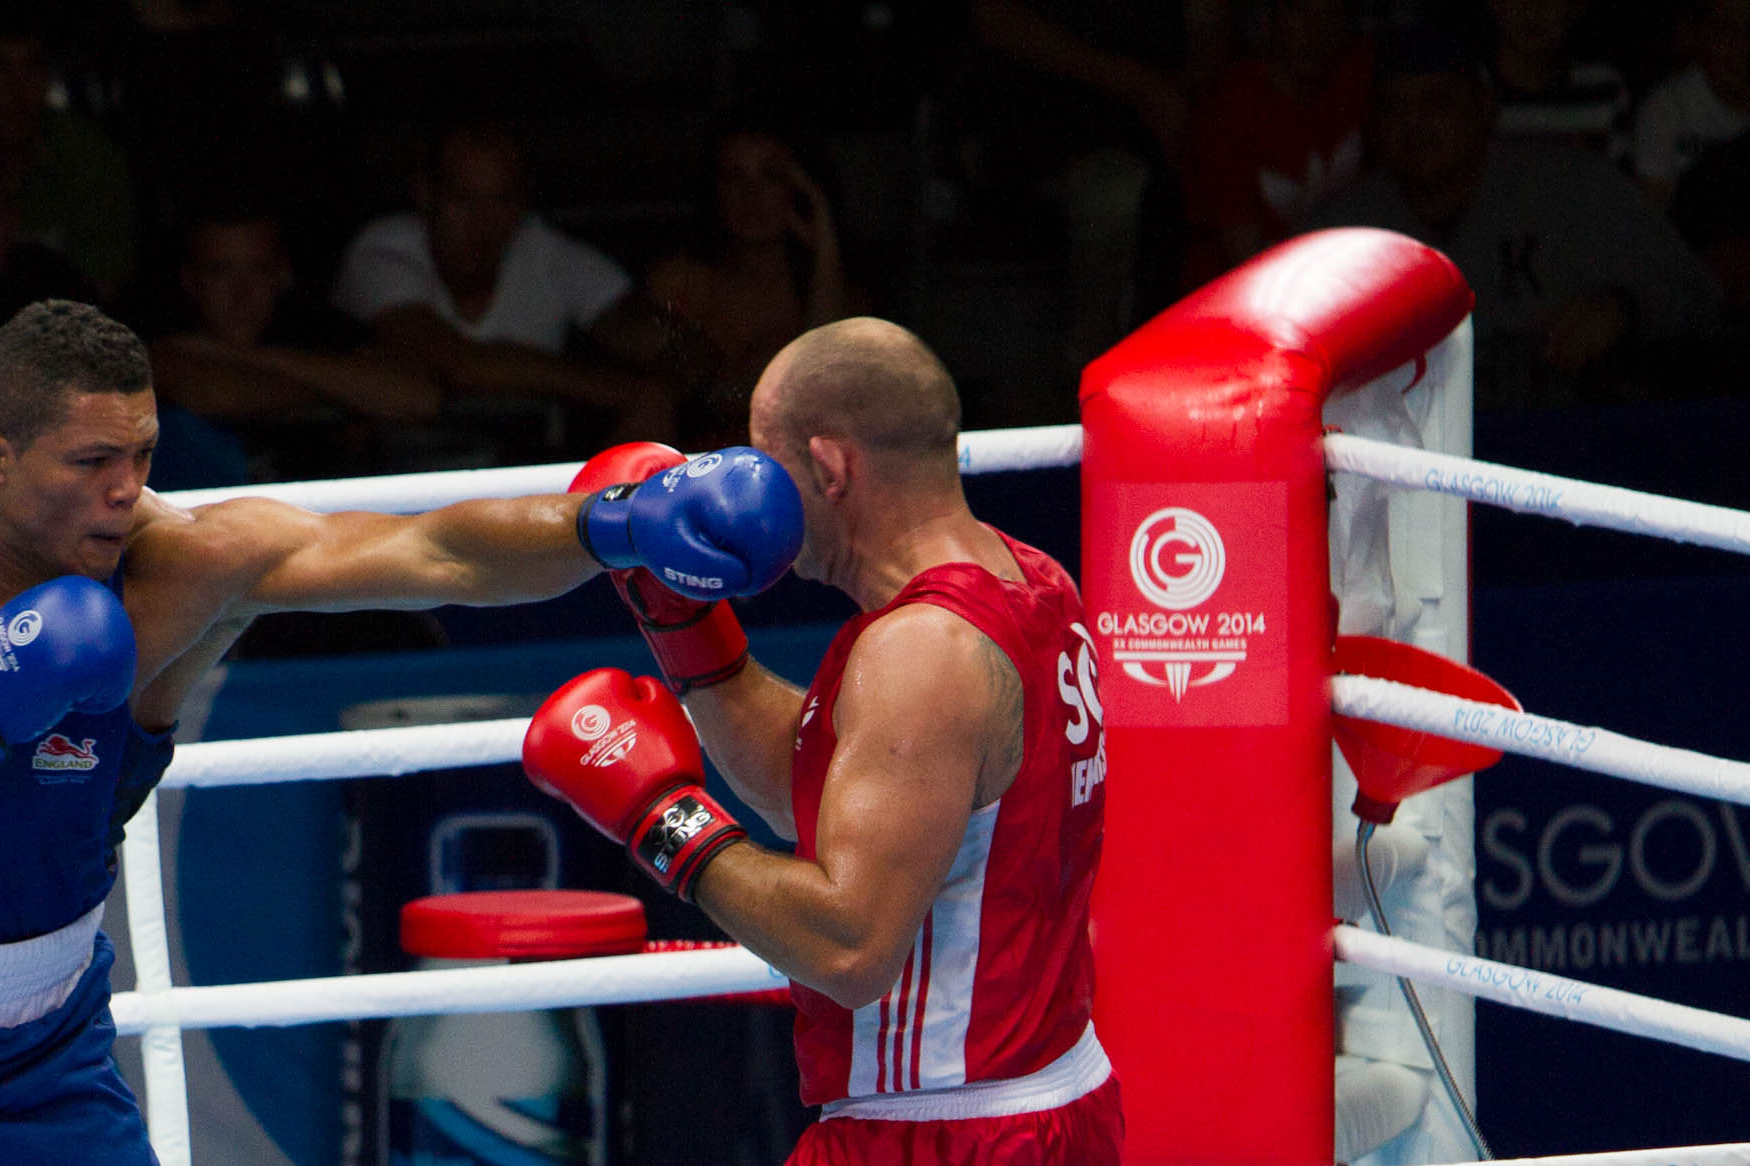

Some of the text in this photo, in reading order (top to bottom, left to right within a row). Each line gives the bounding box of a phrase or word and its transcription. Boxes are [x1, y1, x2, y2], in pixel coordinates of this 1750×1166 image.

[664, 567, 723, 589] STING
[1098, 612, 1266, 635] GLASGOW 2014
[1114, 638, 1247, 650] XX COMMONWEALTH GAMES
[35, 758, 92, 769] ENGLAND
